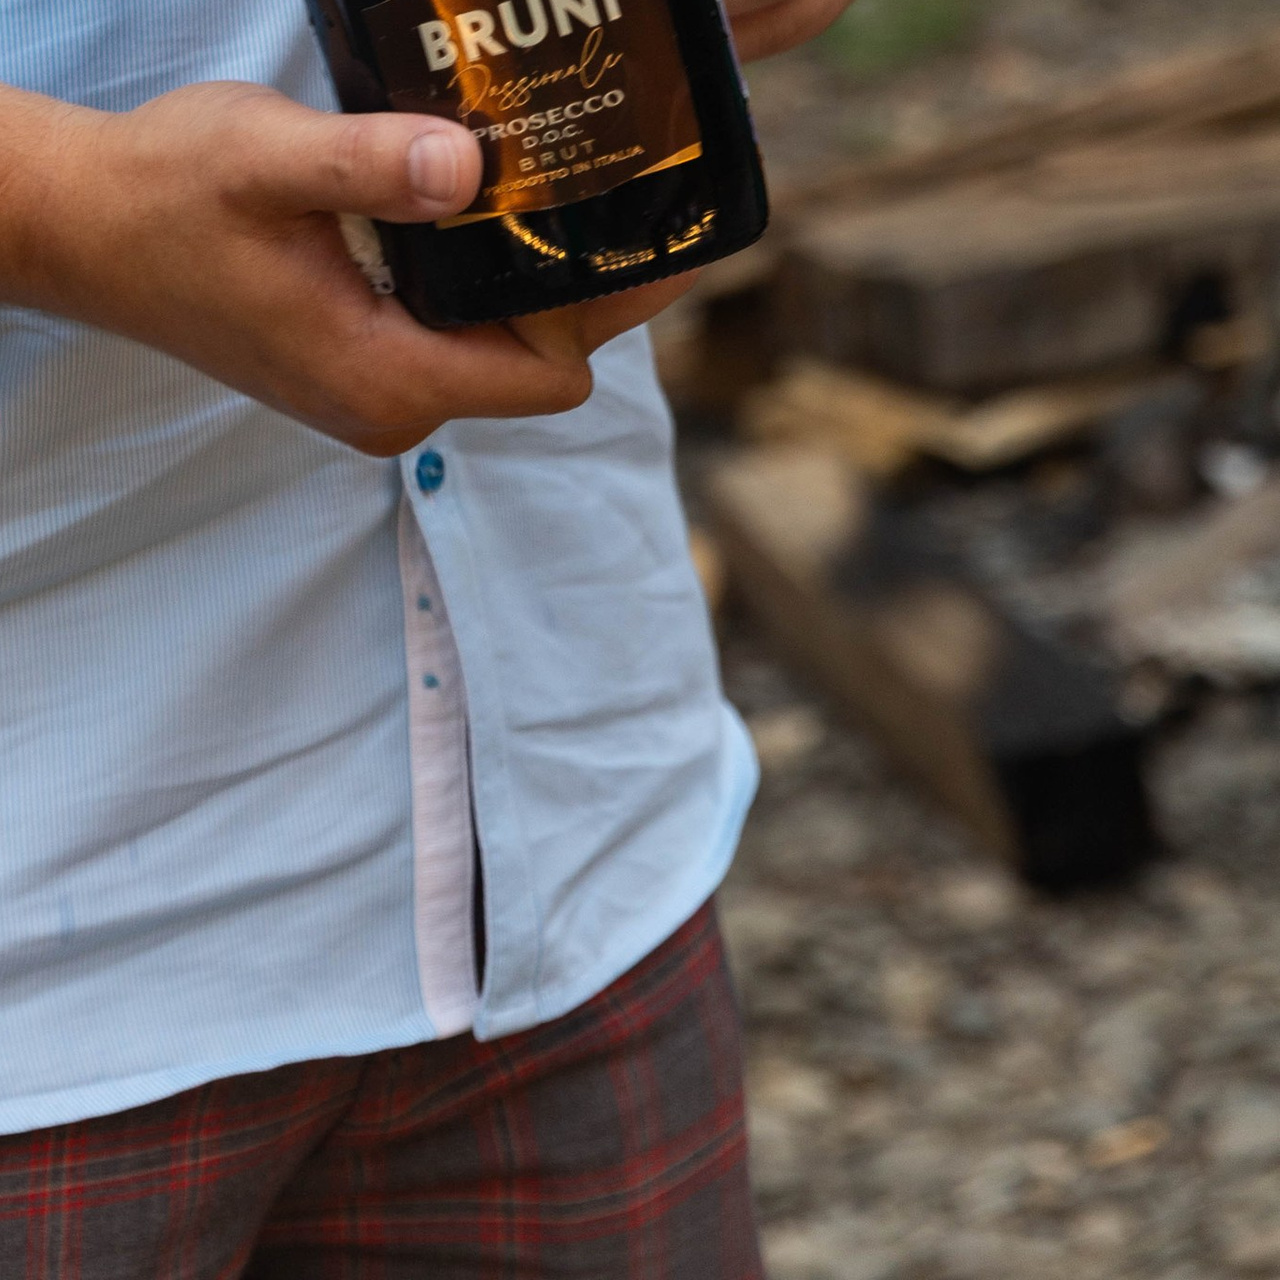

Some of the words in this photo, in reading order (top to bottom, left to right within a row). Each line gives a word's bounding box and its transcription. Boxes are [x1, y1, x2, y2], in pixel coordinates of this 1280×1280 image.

[471, 89, 625, 141] PROSECCO
[521, 124, 584, 150] D.O.C.
[518, 139, 596, 172] BRUT
[572, 159, 592, 175] IN
[594, 145, 646, 169] ITALIA
